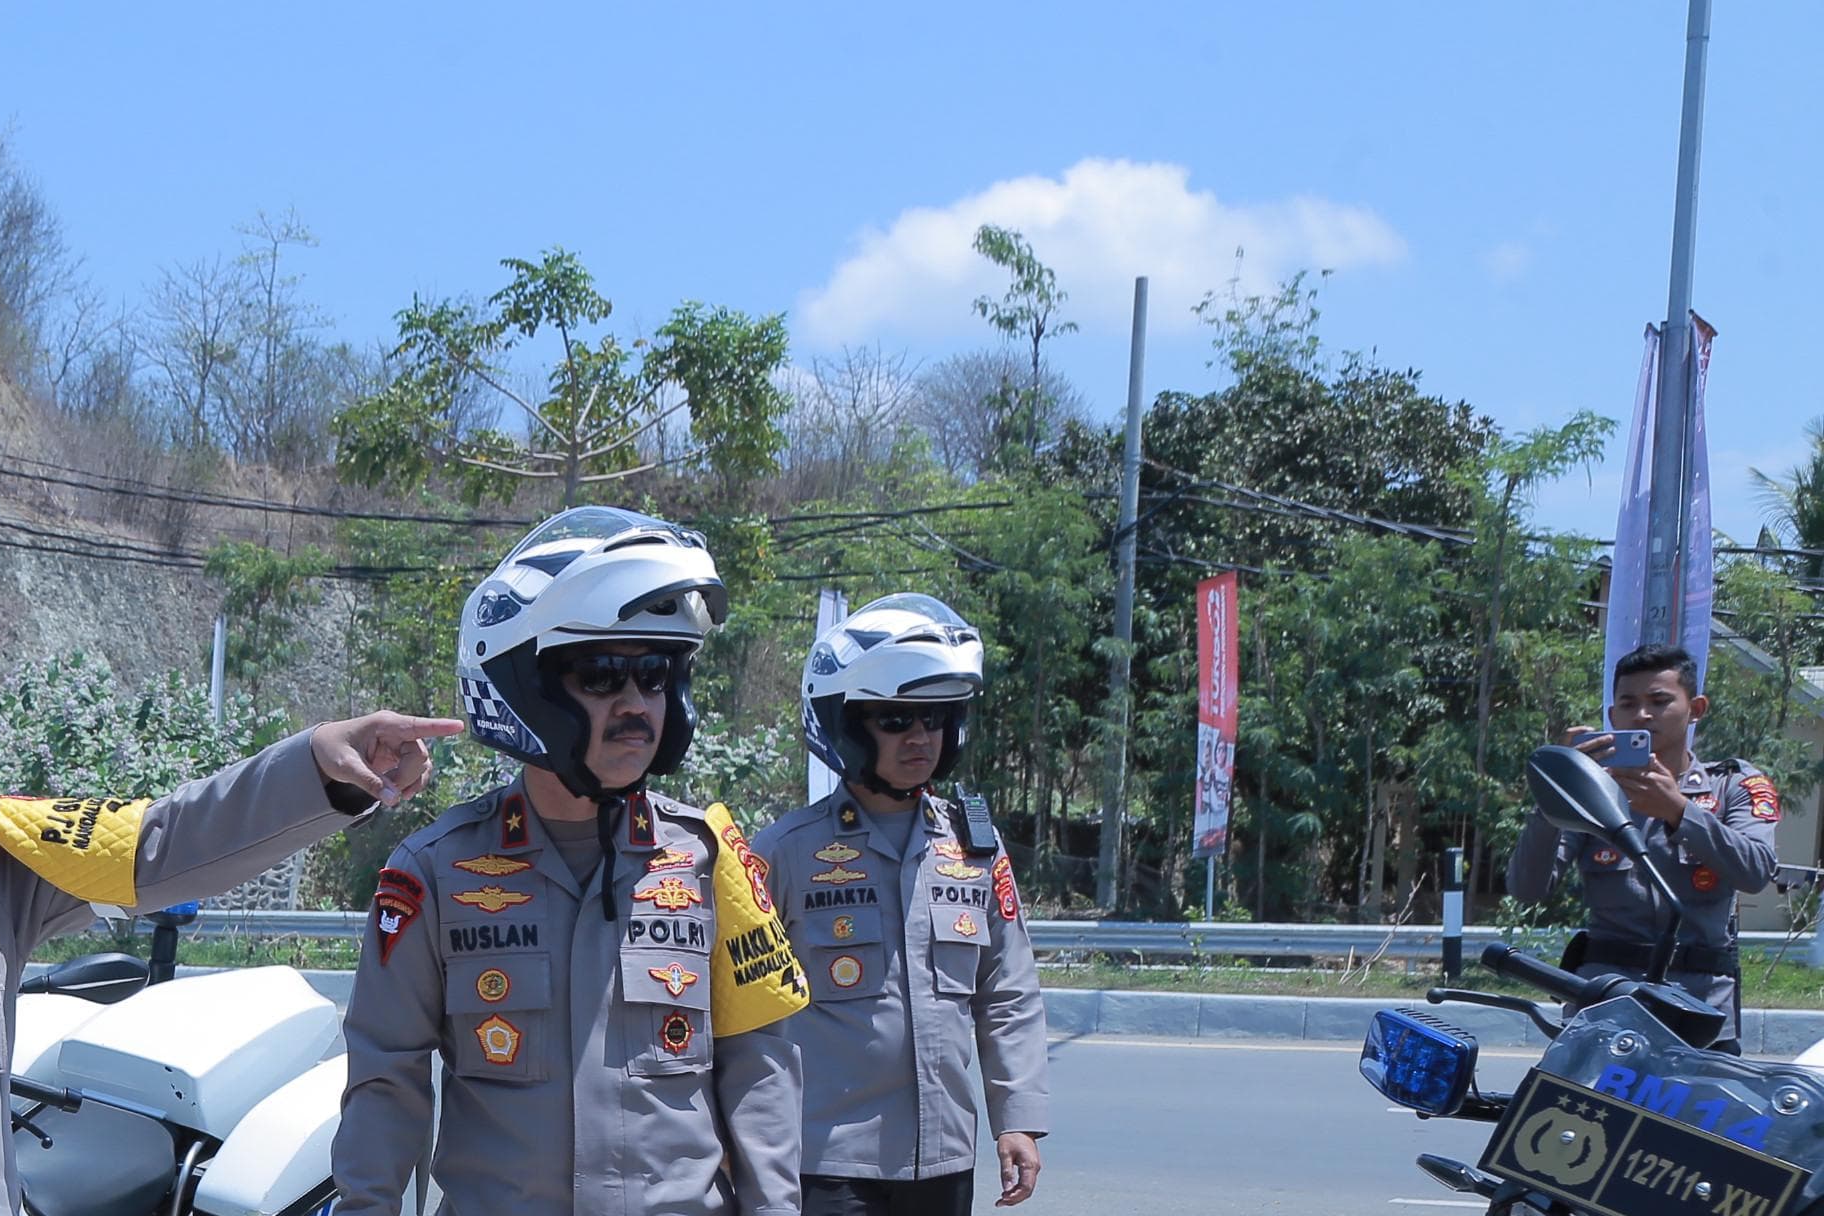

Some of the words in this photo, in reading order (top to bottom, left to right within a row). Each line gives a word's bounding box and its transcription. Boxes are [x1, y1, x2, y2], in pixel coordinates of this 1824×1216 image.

[804, 887, 878, 910] ARIAKTA
[931, 885, 988, 907] POLRI
[449, 923, 539, 953] RUSLAN
[627, 918, 706, 948] POLRI
[725, 925, 775, 967] WAKIL
